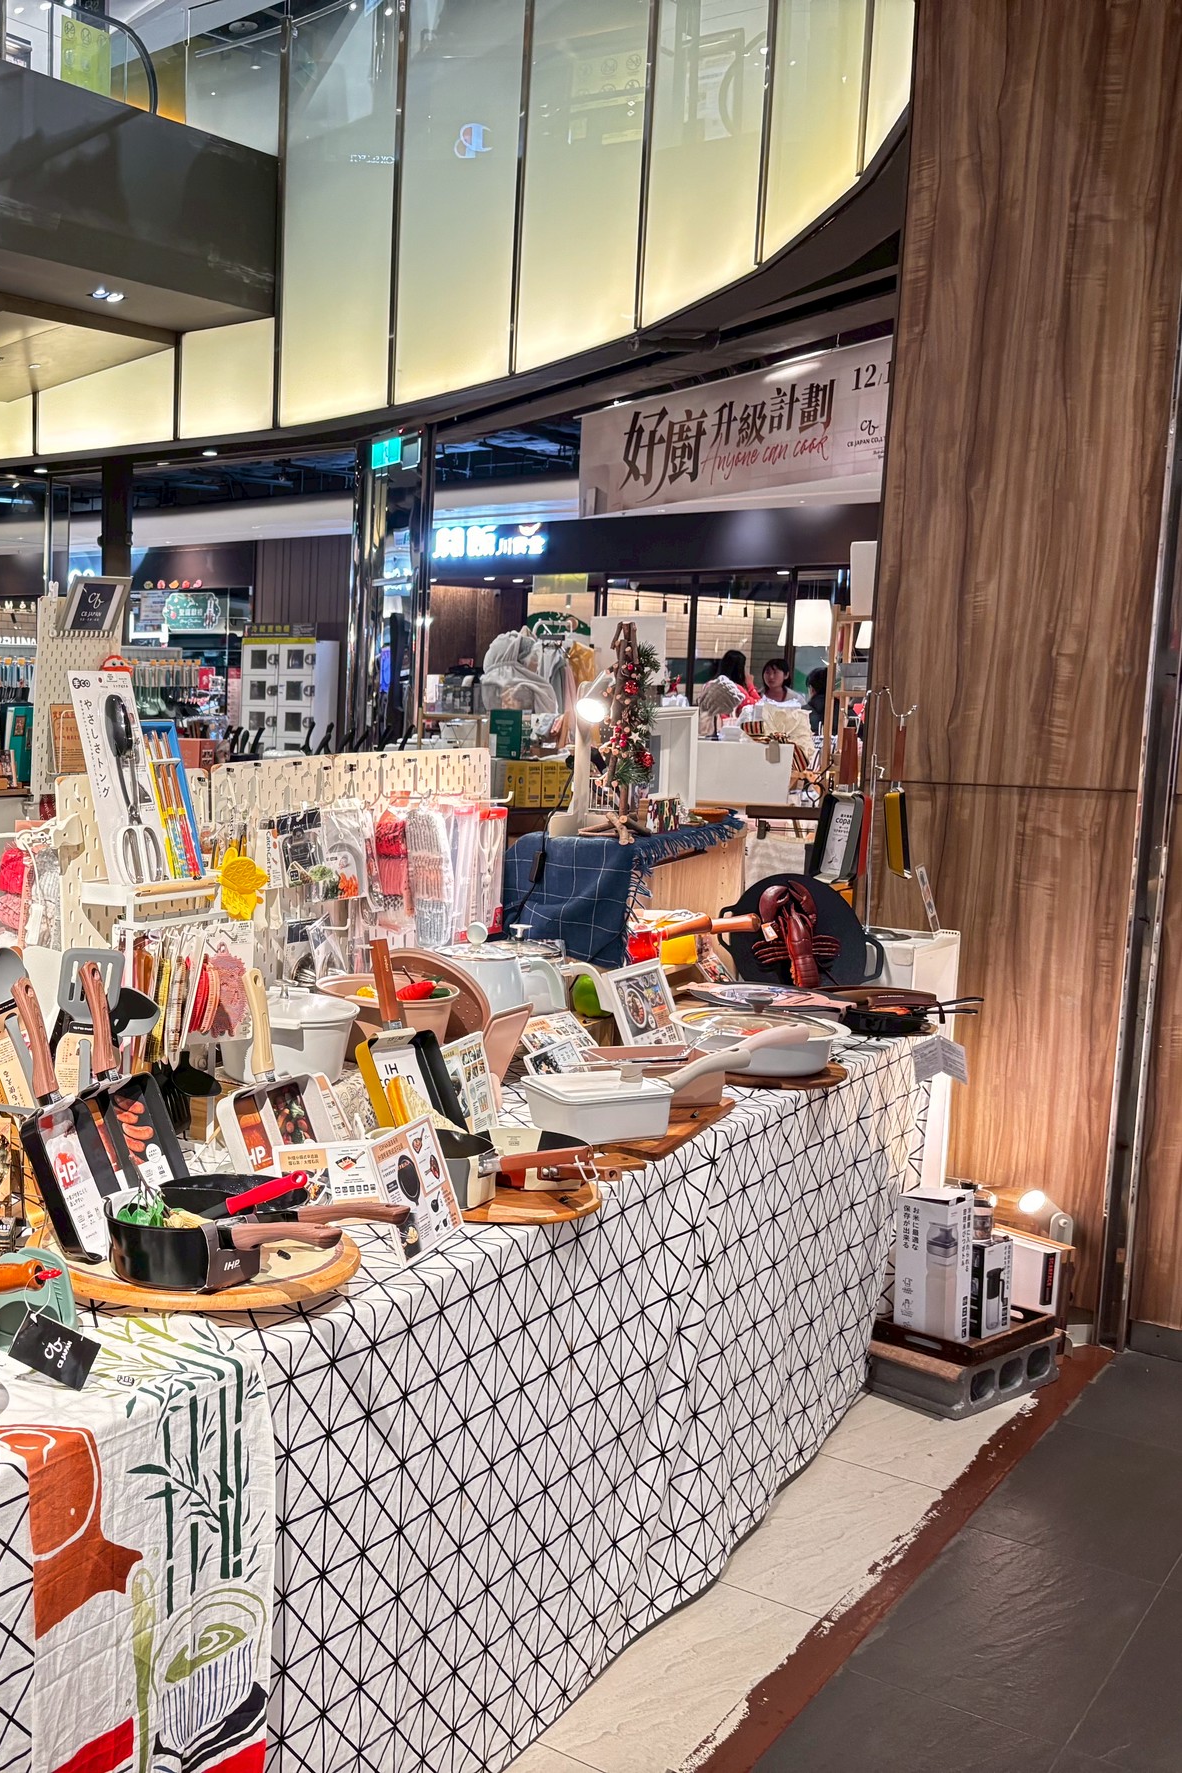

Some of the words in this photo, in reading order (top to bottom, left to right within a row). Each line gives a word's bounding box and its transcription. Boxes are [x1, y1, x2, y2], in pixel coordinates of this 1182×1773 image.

[762, 444, 788, 463] can
[792, 435, 831, 461] cook
[854, 438, 871, 447] JAPAN
[384, 1062, 399, 1076] IH
[903, 1204, 911, 1249] 保存が出来る
[912, 1207, 920, 1251] お米に最適な
[223, 1260, 242, 1272] IHP
[61, 1340, 73, 1361] JAPAN
